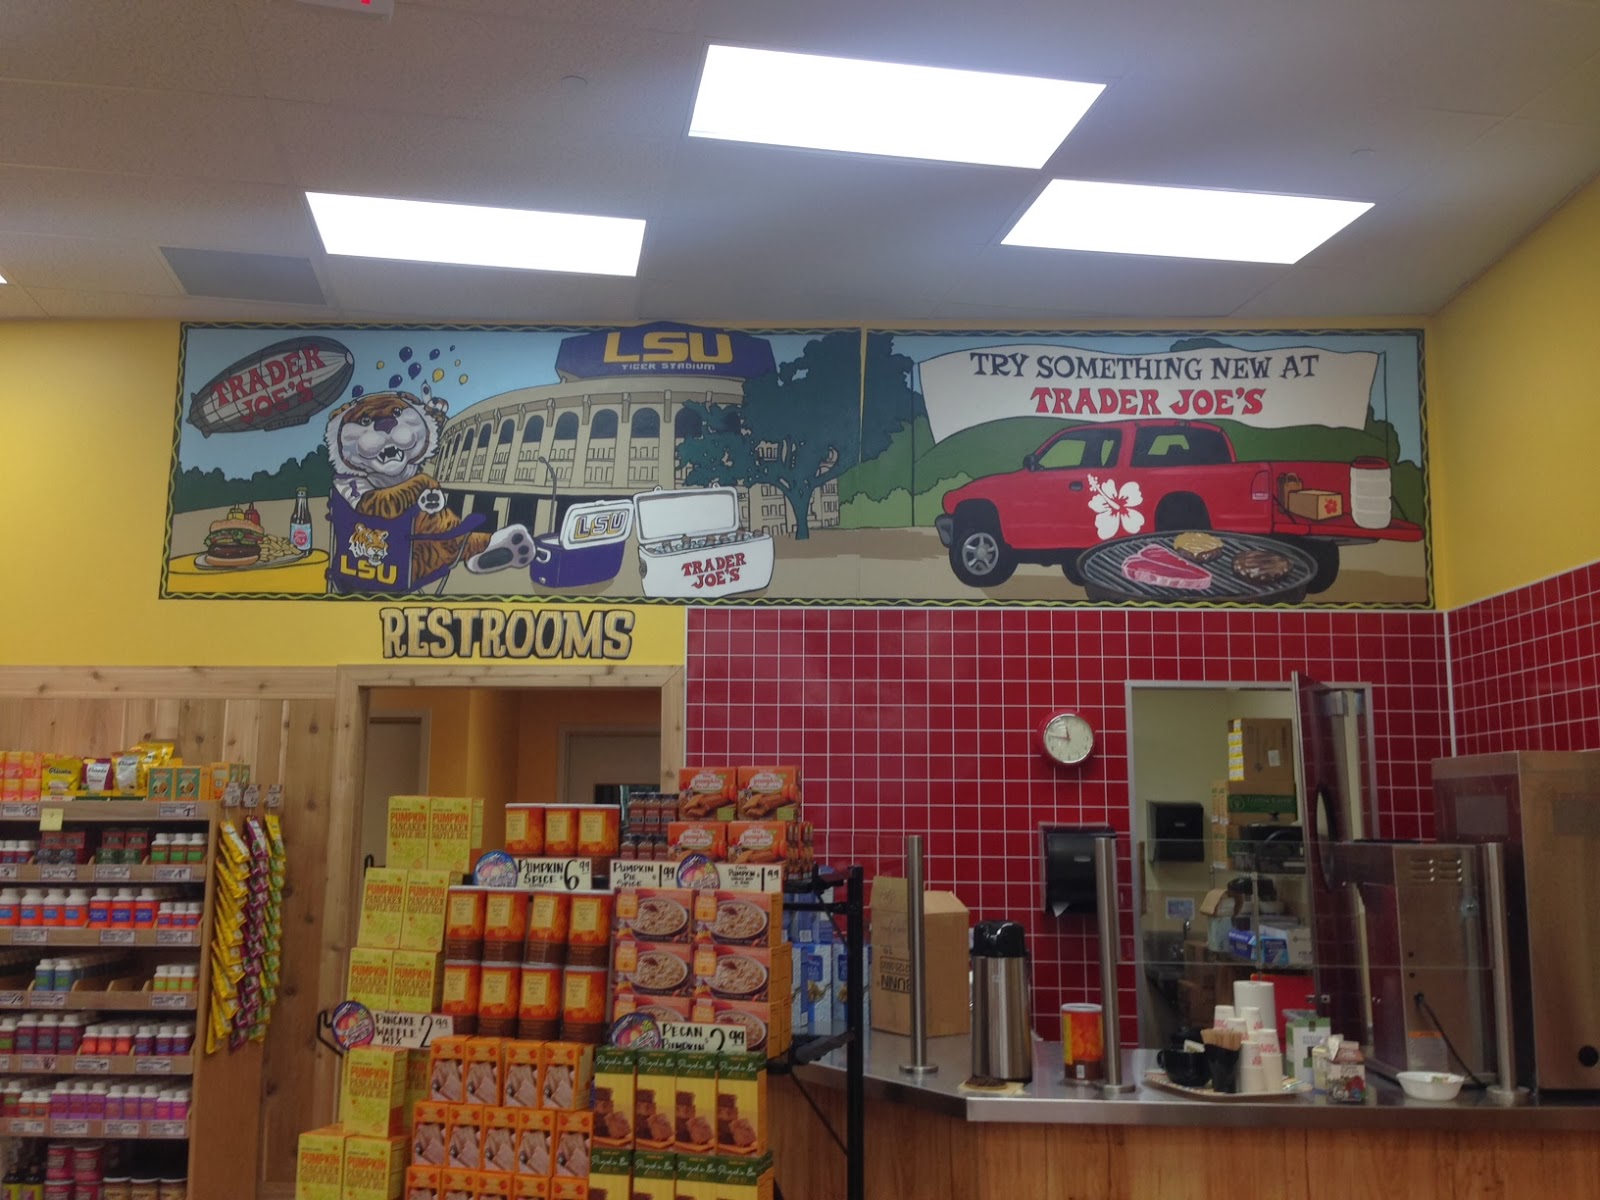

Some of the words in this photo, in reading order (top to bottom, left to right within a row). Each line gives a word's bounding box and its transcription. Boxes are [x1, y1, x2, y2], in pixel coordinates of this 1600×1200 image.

[603, 331, 733, 364] LSU
[661, 362, 716, 371] STADIUM
[970, 352, 1029, 377] TRY
[1036, 355, 1202, 381] SOMETHING
[1211, 356, 1272, 380] NEW
[1279, 354, 1319, 379] AT
[211, 344, 326, 407] TRADER
[240, 377, 314, 424] JOE'S
[1030, 386, 1161, 415] TRADER
[1169, 386, 1267, 415] JOE'S
[574, 512, 627, 539] LSU
[340, 554, 397, 585] LSU
[681, 552, 747, 576] TRADER
[691, 567, 740, 589] JOE'S
[380, 607, 636, 660] RESTROOMS
[391, 812, 427, 822] PUMPKIN
[433, 812, 469, 823] PUMPKIN
[518, 859, 563, 873] PUMPKIN
[613, 862, 654, 873] PUMPKIN
[524, 873, 557, 884] SPICE
[367, 884, 403, 895] PUMPKIN
[409, 886, 445, 898] PUMPKIN
[352, 965, 388, 977] PUMPKIN
[394, 967, 431, 979] PUMPKIN
[375, 1013, 415, 1027] PANCAKE
[375, 1026, 417, 1039] WAFFLE
[662, 1024, 703, 1037] PECAN
[382, 1036, 402, 1045] MIX
